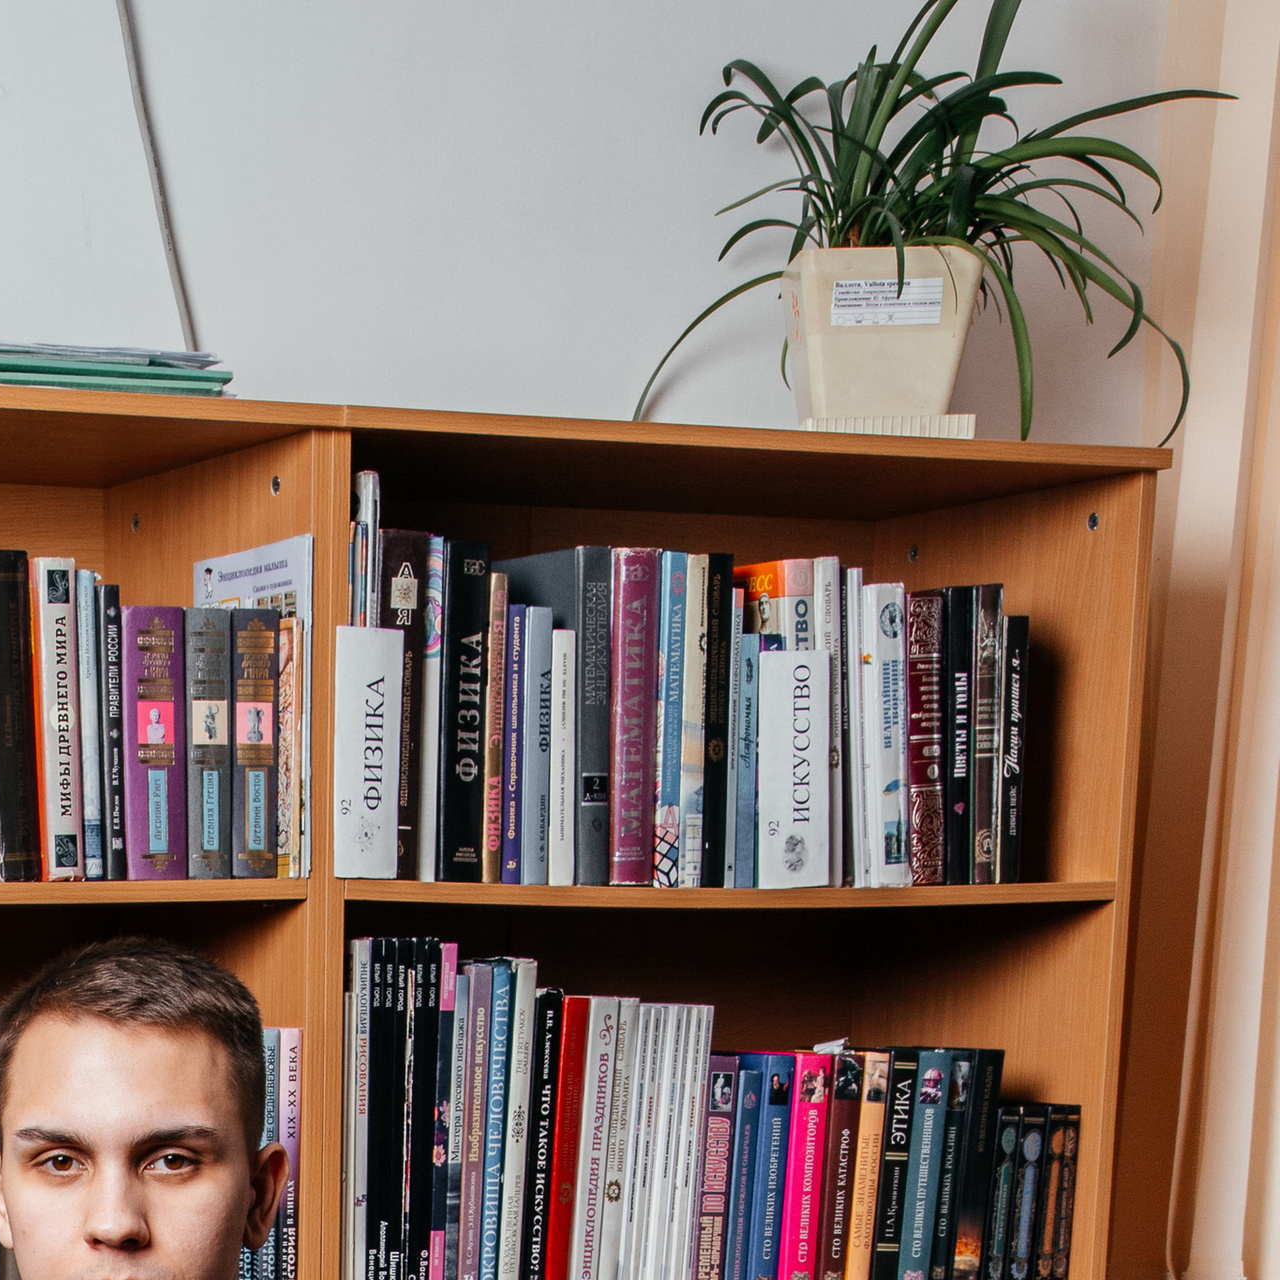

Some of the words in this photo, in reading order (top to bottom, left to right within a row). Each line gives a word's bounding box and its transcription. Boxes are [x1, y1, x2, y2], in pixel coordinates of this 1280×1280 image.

[55, 614, 69, 667] МИРА
[106, 624, 119, 661] РОССИИ
[57, 672, 72, 758] ДРЕВНЕГО
[108, 665, 120, 718] ПРАВИТЕЛИ
[455, 631, 483, 783] ФИЗИКА
[511, 672, 519, 730] школьника
[620, 597, 647, 838] МАТЕМАТИКА
[955, 672, 968, 710] ГОДЫ
[363, 674, 386, 811] ФИЗИКА
[792, 663, 812, 824] ИСКУССТВО
[955, 714, 967, 724] И
[508, 733, 518, 792] Справочник
[954, 728, 968, 778] ЦВЕТЫ
[59, 767, 74, 818] МИФЫ
[340, 799, 352, 815] 92
[507, 800, 516, 840] Физика
[768, 820, 780, 837] 92
[486, 983, 511, 1159] ЧЕЛОВЕЧЕСТВА
[591, 1051, 610, 1153] ПРАЗДНИКОВ
[890, 1078, 912, 1146] ЭТИКА
[802, 1108, 819, 1189] КОМПОЗИТОРОВ
[581, 1155, 602, 1280] ЭНЦИКЛОПЕДИЯ
[799, 1191, 813, 1237] ВЕЛИКИХ
[796, 1239, 808, 1264] СТО
